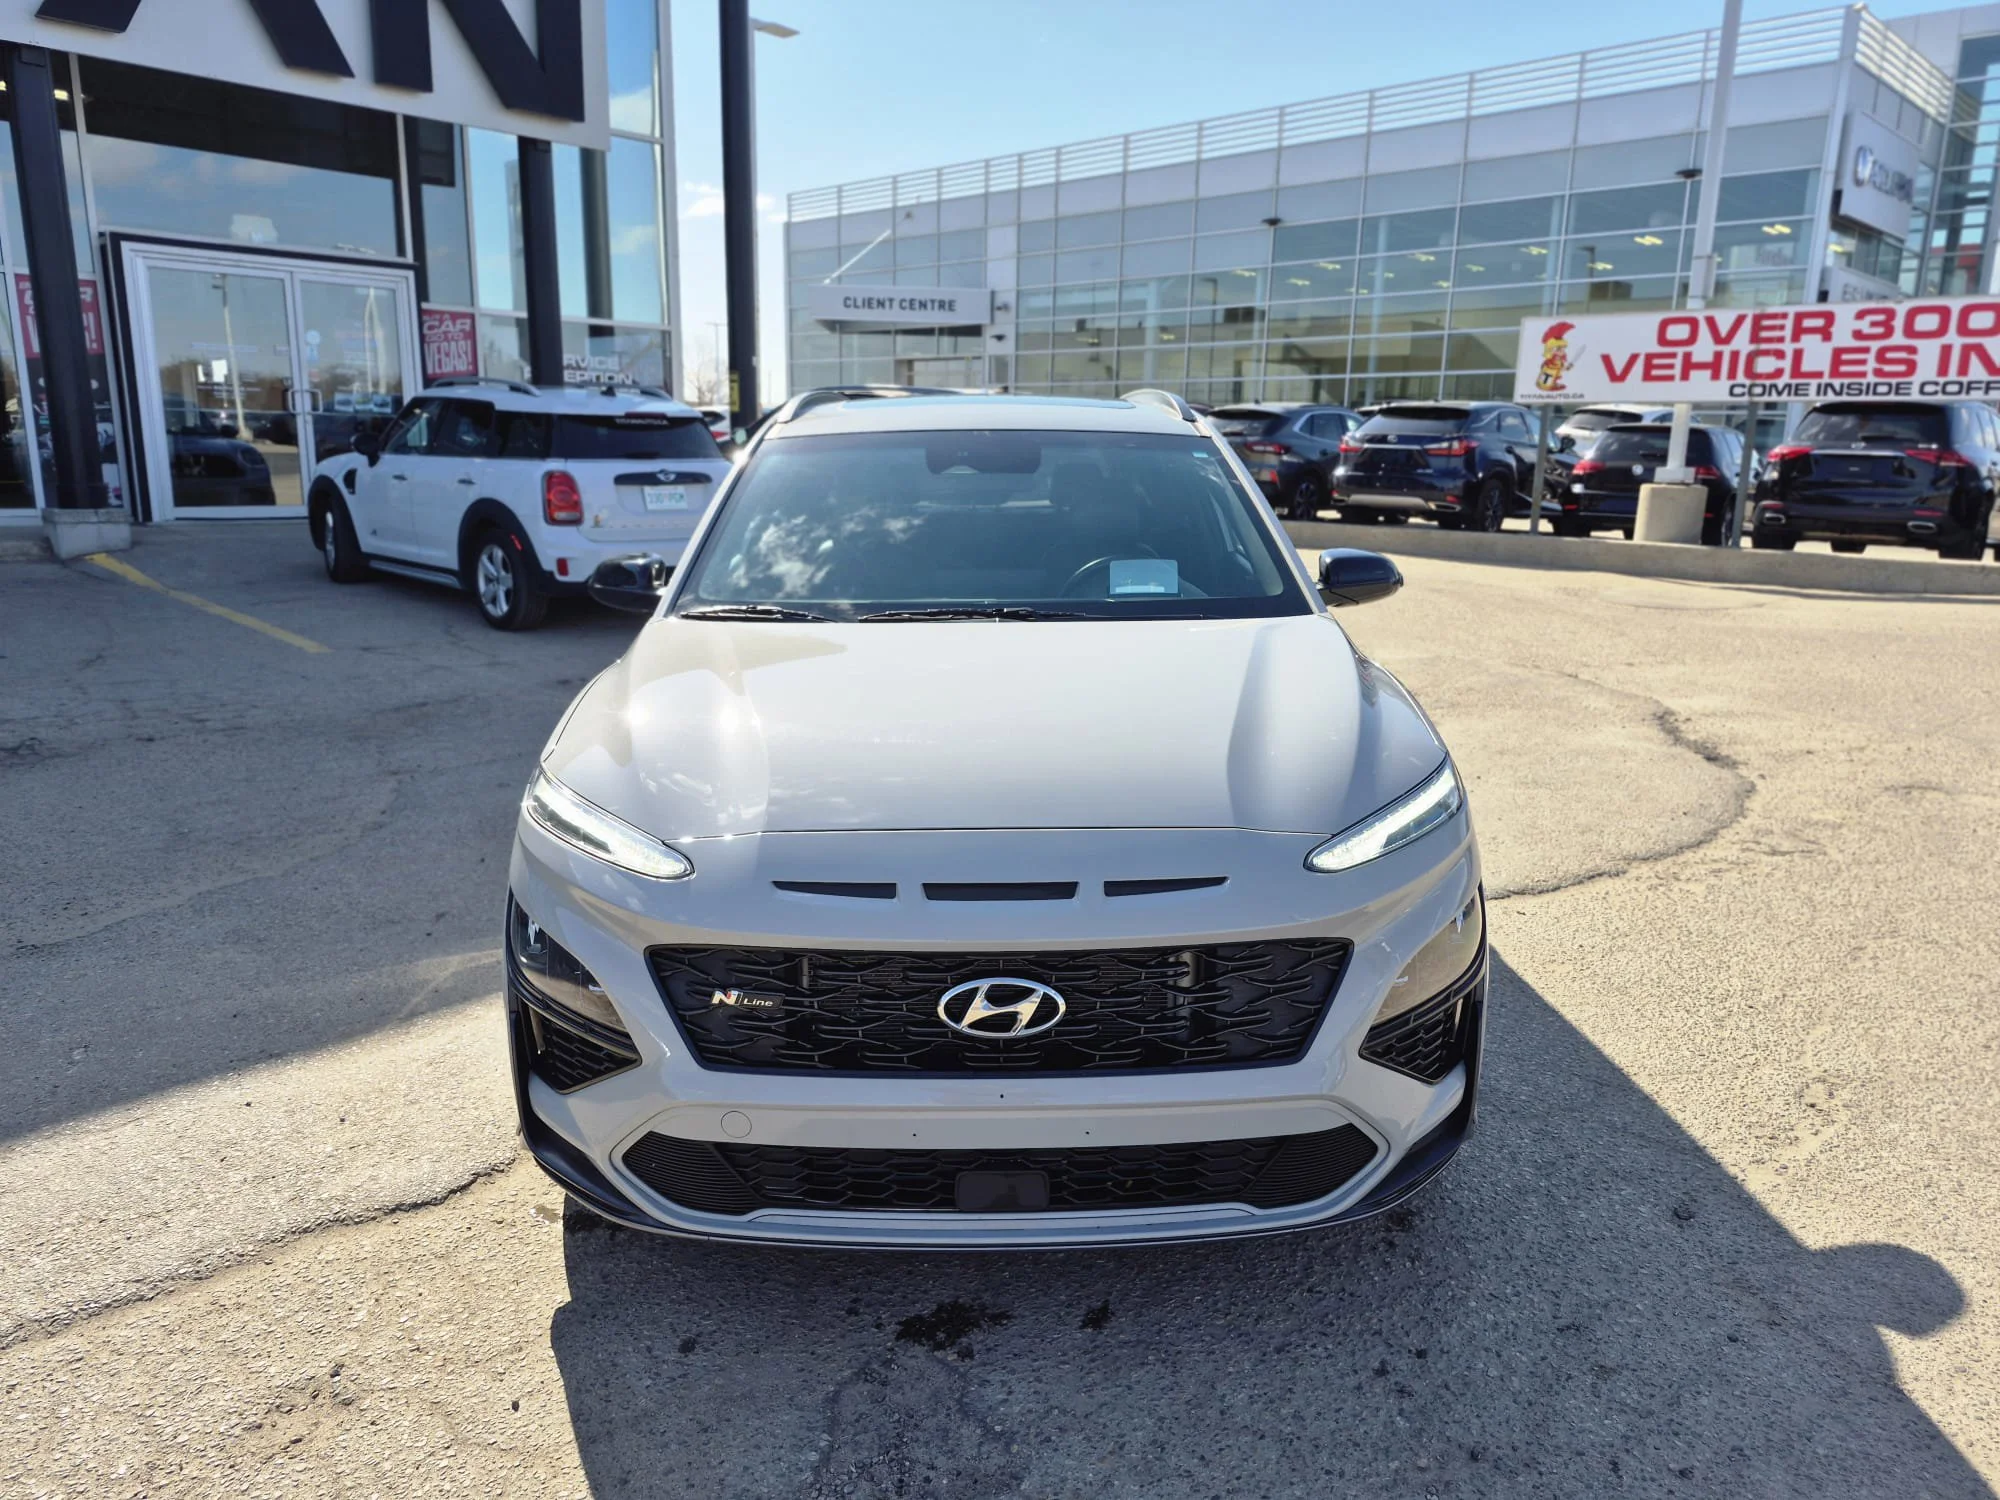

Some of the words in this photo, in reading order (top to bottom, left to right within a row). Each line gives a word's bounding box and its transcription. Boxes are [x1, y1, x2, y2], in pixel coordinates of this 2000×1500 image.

[843, 296, 895, 310] CLIENT
[900, 298, 957, 312] CENTRE
[423, 319, 471, 335] CAR
[1657, 310, 1836, 348] OVER
[1852, 302, 2000, 342] 300
[446, 332, 464, 341] TO
[424, 340, 473, 375] VEGAS!
[563, 353, 620, 372] RVICE
[1600, 344, 1918, 383] VEHICLES
[1729, 382, 1811, 398] COME
[1816, 380, 1913, 397] INSIDE
[1918, 380, 2000, 397] COFF
[743, 998, 773, 1007] Line
